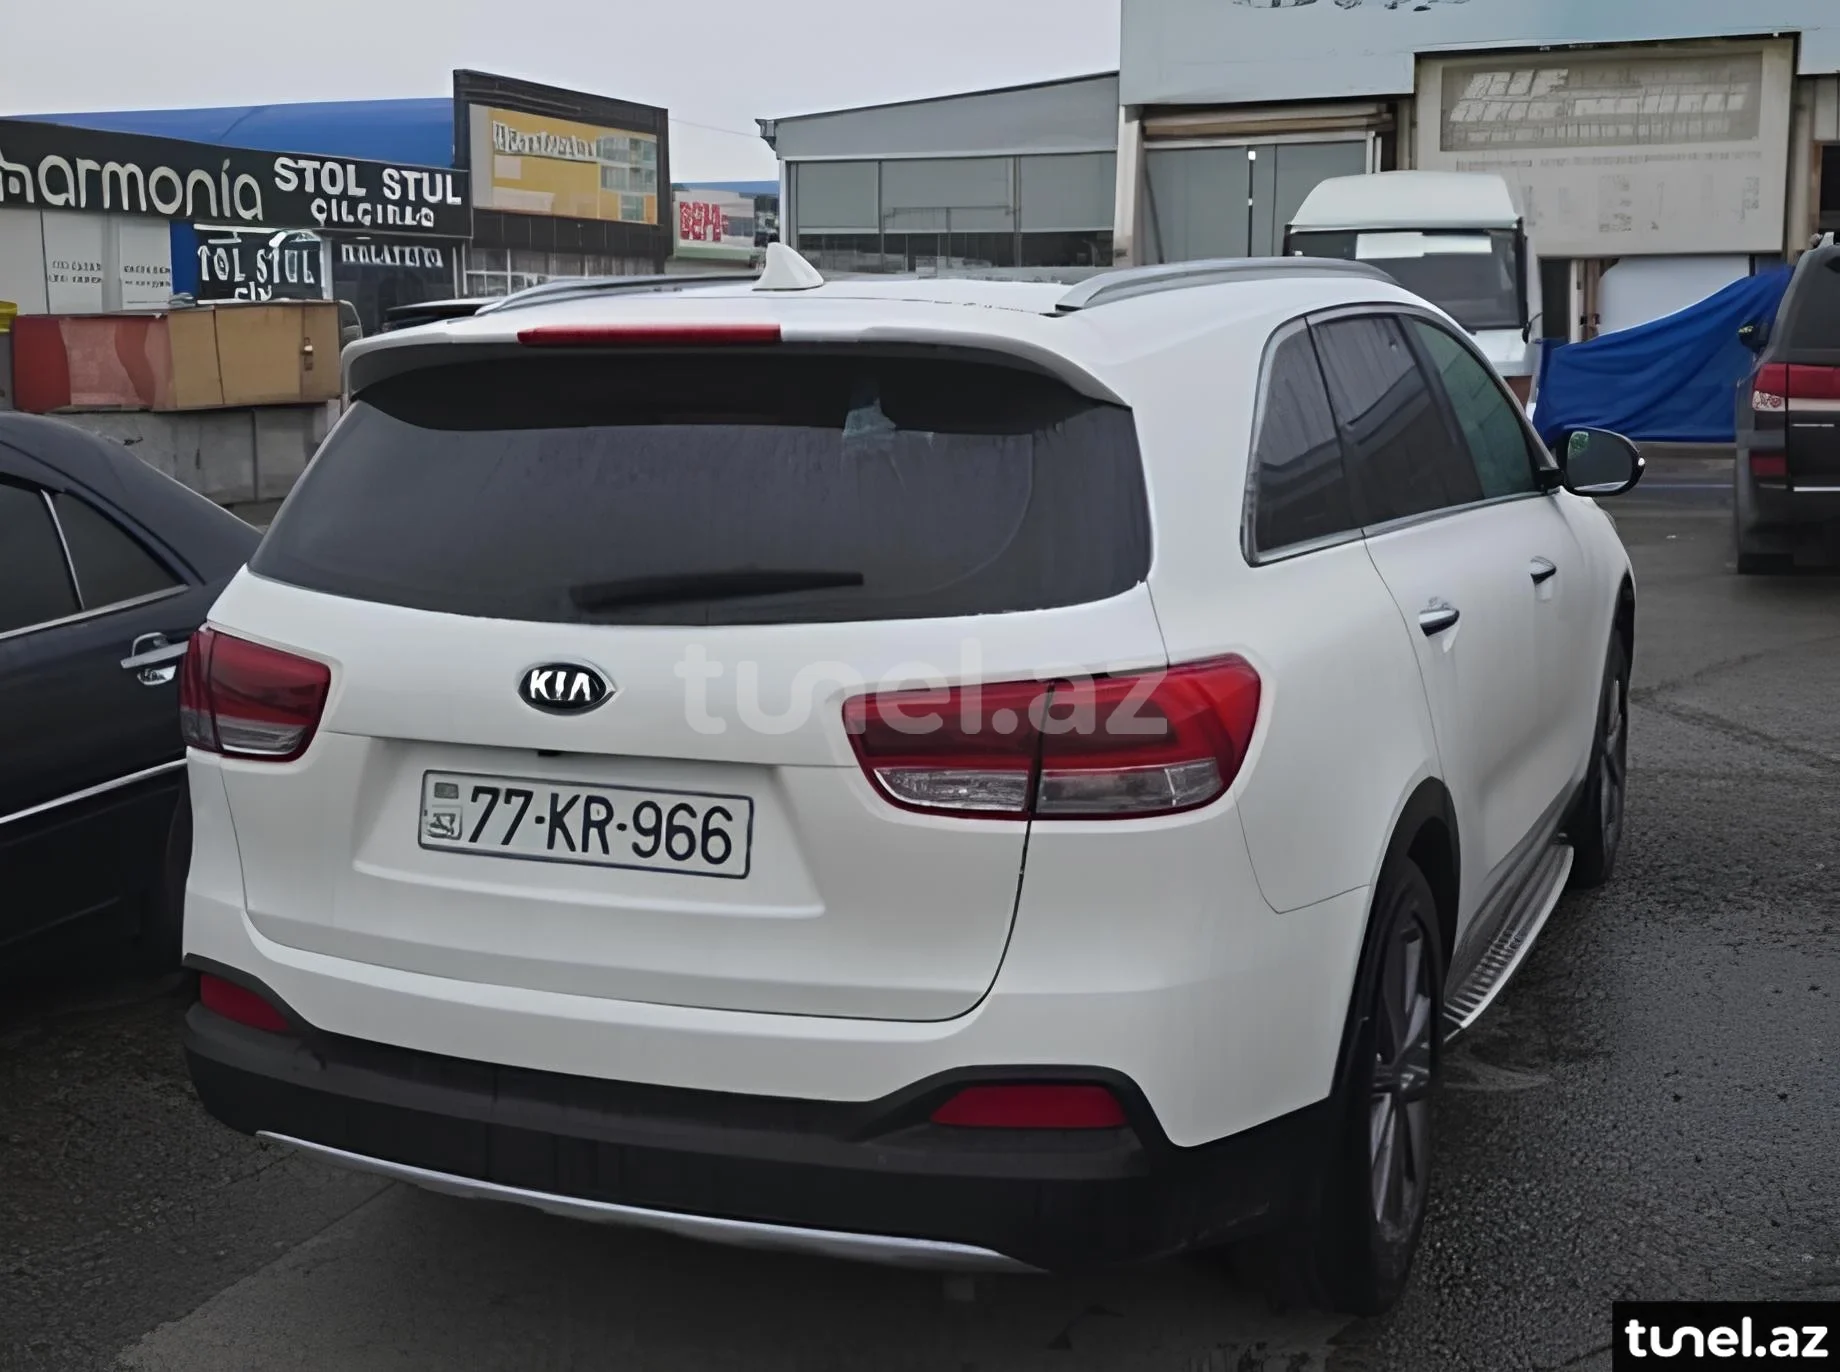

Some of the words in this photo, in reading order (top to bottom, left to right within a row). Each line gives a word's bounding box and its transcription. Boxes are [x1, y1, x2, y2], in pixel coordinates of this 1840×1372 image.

[273, 156, 367, 197] STOL
[382, 167, 462, 205] STUL
[530, 669, 591, 701] KIA
